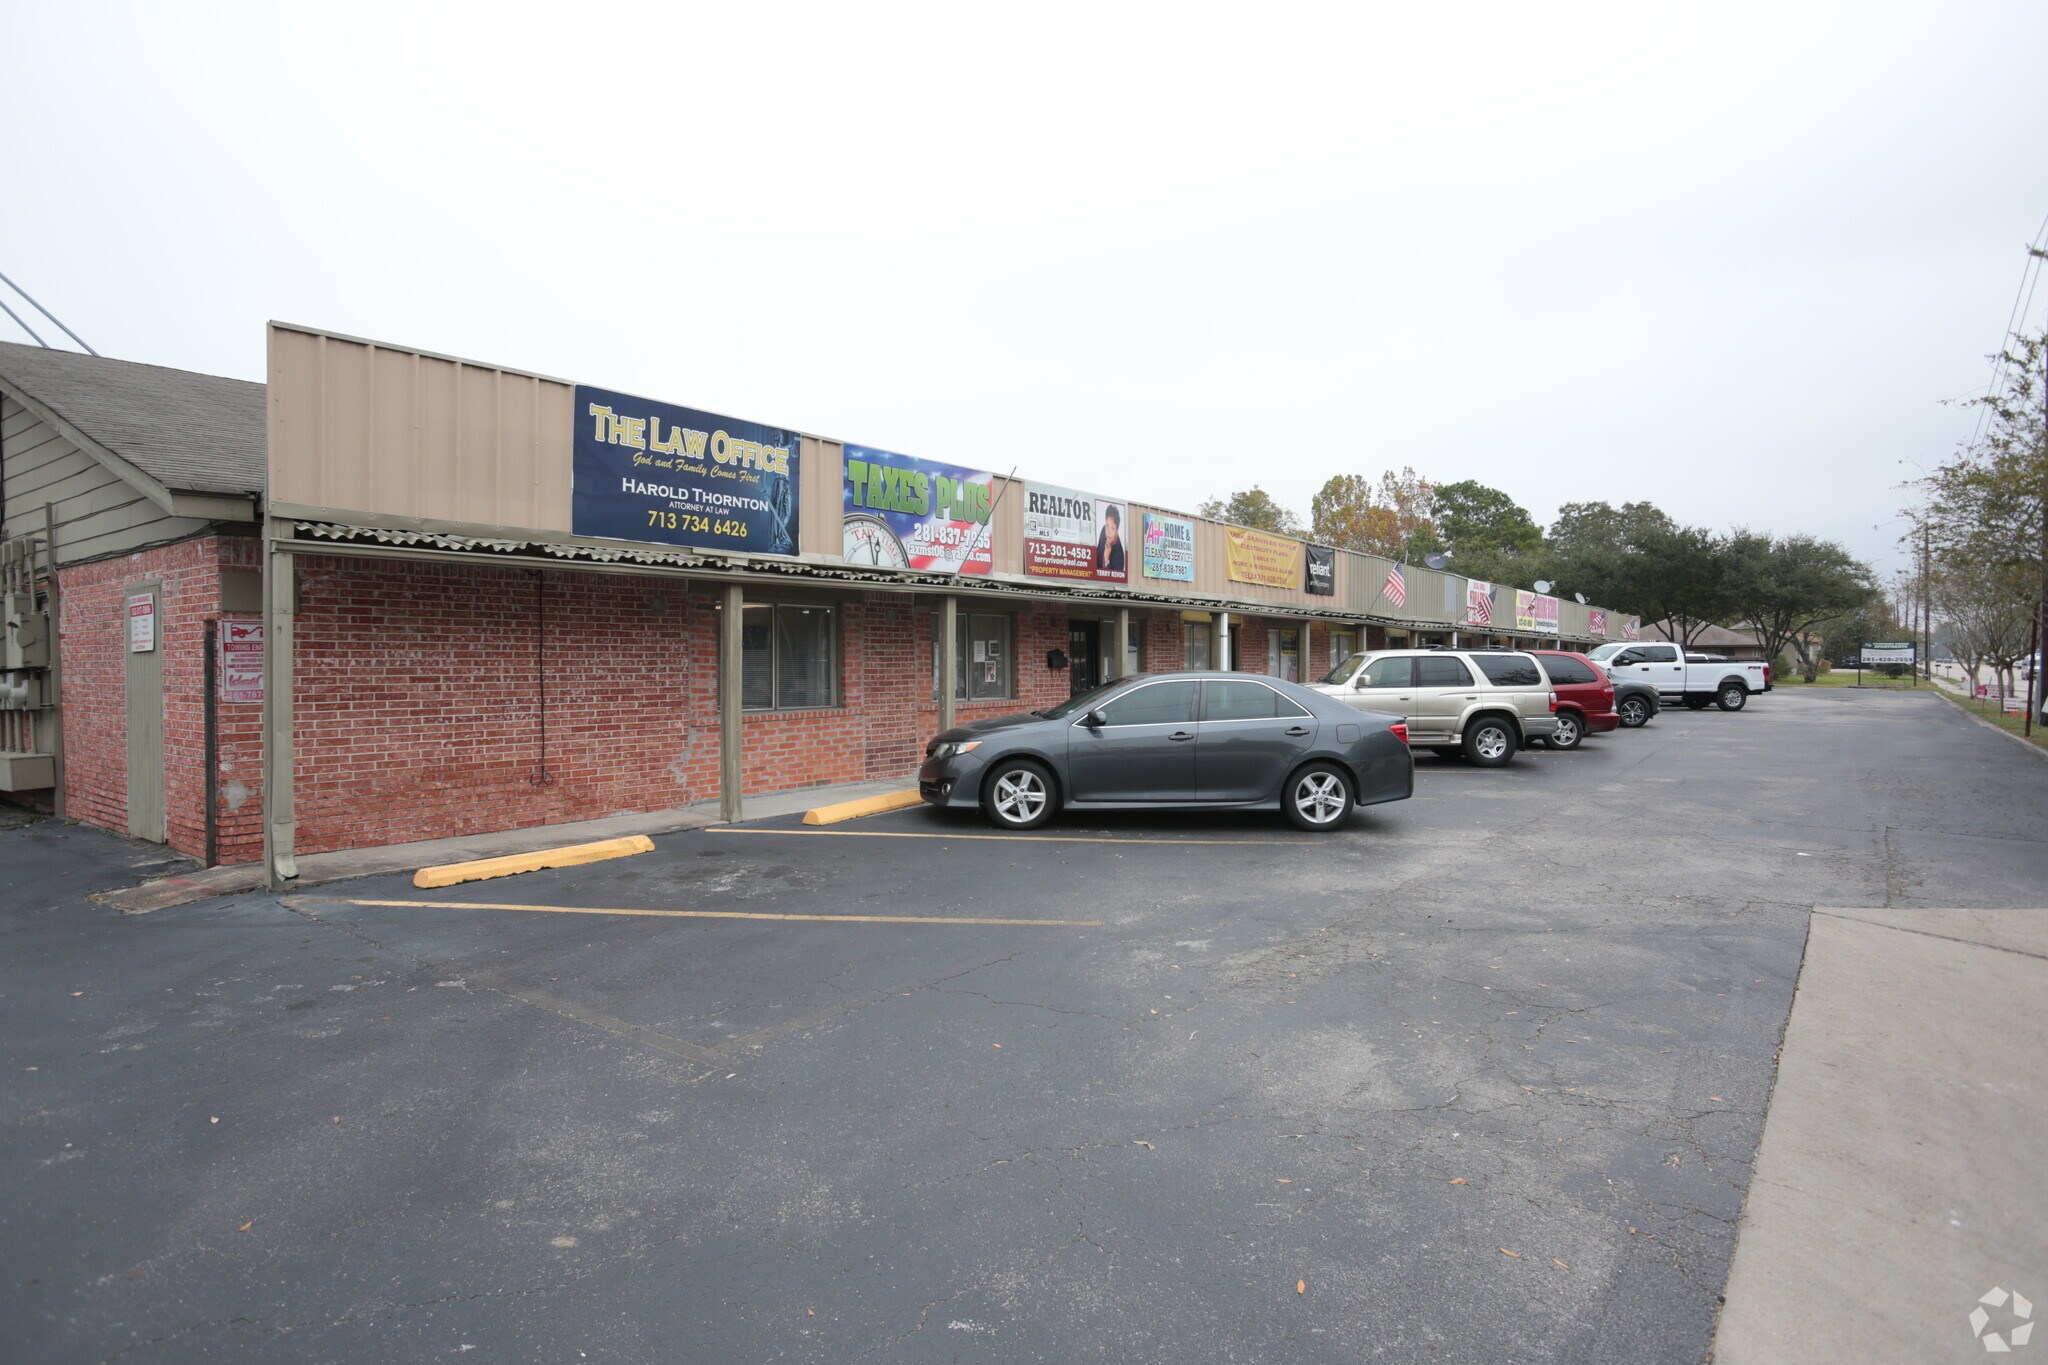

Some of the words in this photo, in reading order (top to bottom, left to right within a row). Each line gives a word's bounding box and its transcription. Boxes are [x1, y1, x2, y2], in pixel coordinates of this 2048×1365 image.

[589, 402, 645, 450] THE
[650, 417, 708, 460] LAW
[710, 429, 790, 475] OFFICE
[632, 451, 653, 467] God
[655, 459, 673, 470] and
[675, 459, 707, 477] Family
[709, 466, 737, 481] Comes
[738, 470, 761, 484] First
[622, 477, 689, 501] HAROLD
[691, 488, 769, 512] THORNTON
[847, 458, 929, 517] TAXES
[935, 475, 991, 526] PLUS
[668, 500, 704, 513] ATTORNEY
[704, 505, 714, 513] AT
[714, 506, 730, 516] LAW
[1028, 491, 1092, 522] REALTOR
[648, 510, 678, 531] 713
[681, 514, 710, 534] 734
[714, 518, 748, 539] 6426
[1038, 529, 1050, 538] MLS
[1164, 523, 1185, 541] HOME
[1185, 529, 1191, 541] &
[851, 528, 877, 542] TAX
[914, 522, 991, 550] 281-837-7955
[881, 536, 899, 560] TIME
[1028, 543, 1092, 561] 713-301-4582
[1165, 538, 1193, 552] COMMERCIAL
[1145, 546, 1170, 561] CLEANING
[1170, 549, 1193, 563] SERVICES
[1096, 569, 1110, 577] TERRY
[1111, 570, 1125, 579] RIVON
[1310, 560, 1331, 577] reliant
[227, 643, 251, 651] TOWING
